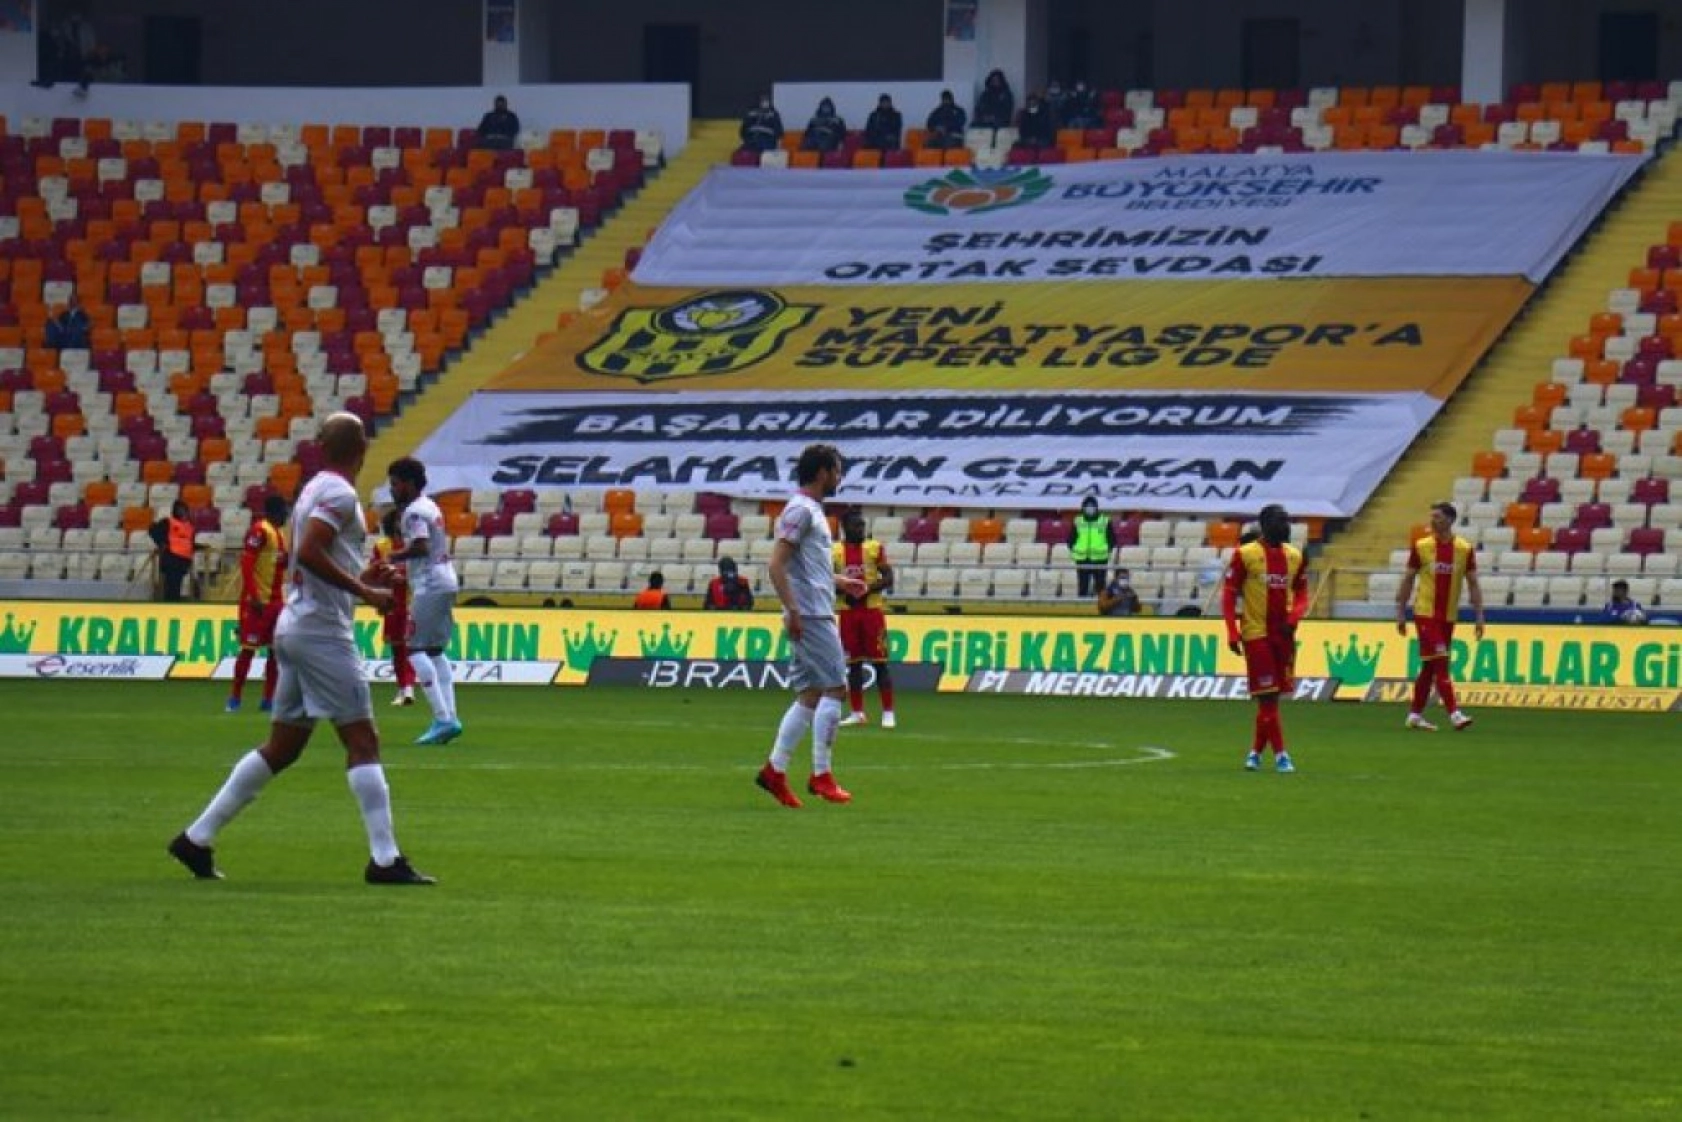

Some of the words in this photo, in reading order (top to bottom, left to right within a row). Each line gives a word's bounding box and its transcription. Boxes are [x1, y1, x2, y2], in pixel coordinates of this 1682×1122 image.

[826, 258, 1037, 282] ORTAK
[813, 322, 1424, 347] MALATYASPOR'A
[573, 409, 930, 436] BAŞARILAR
[1020, 631, 1218, 675] KAZANIN
[1024, 673, 1158, 697] MERCAN
